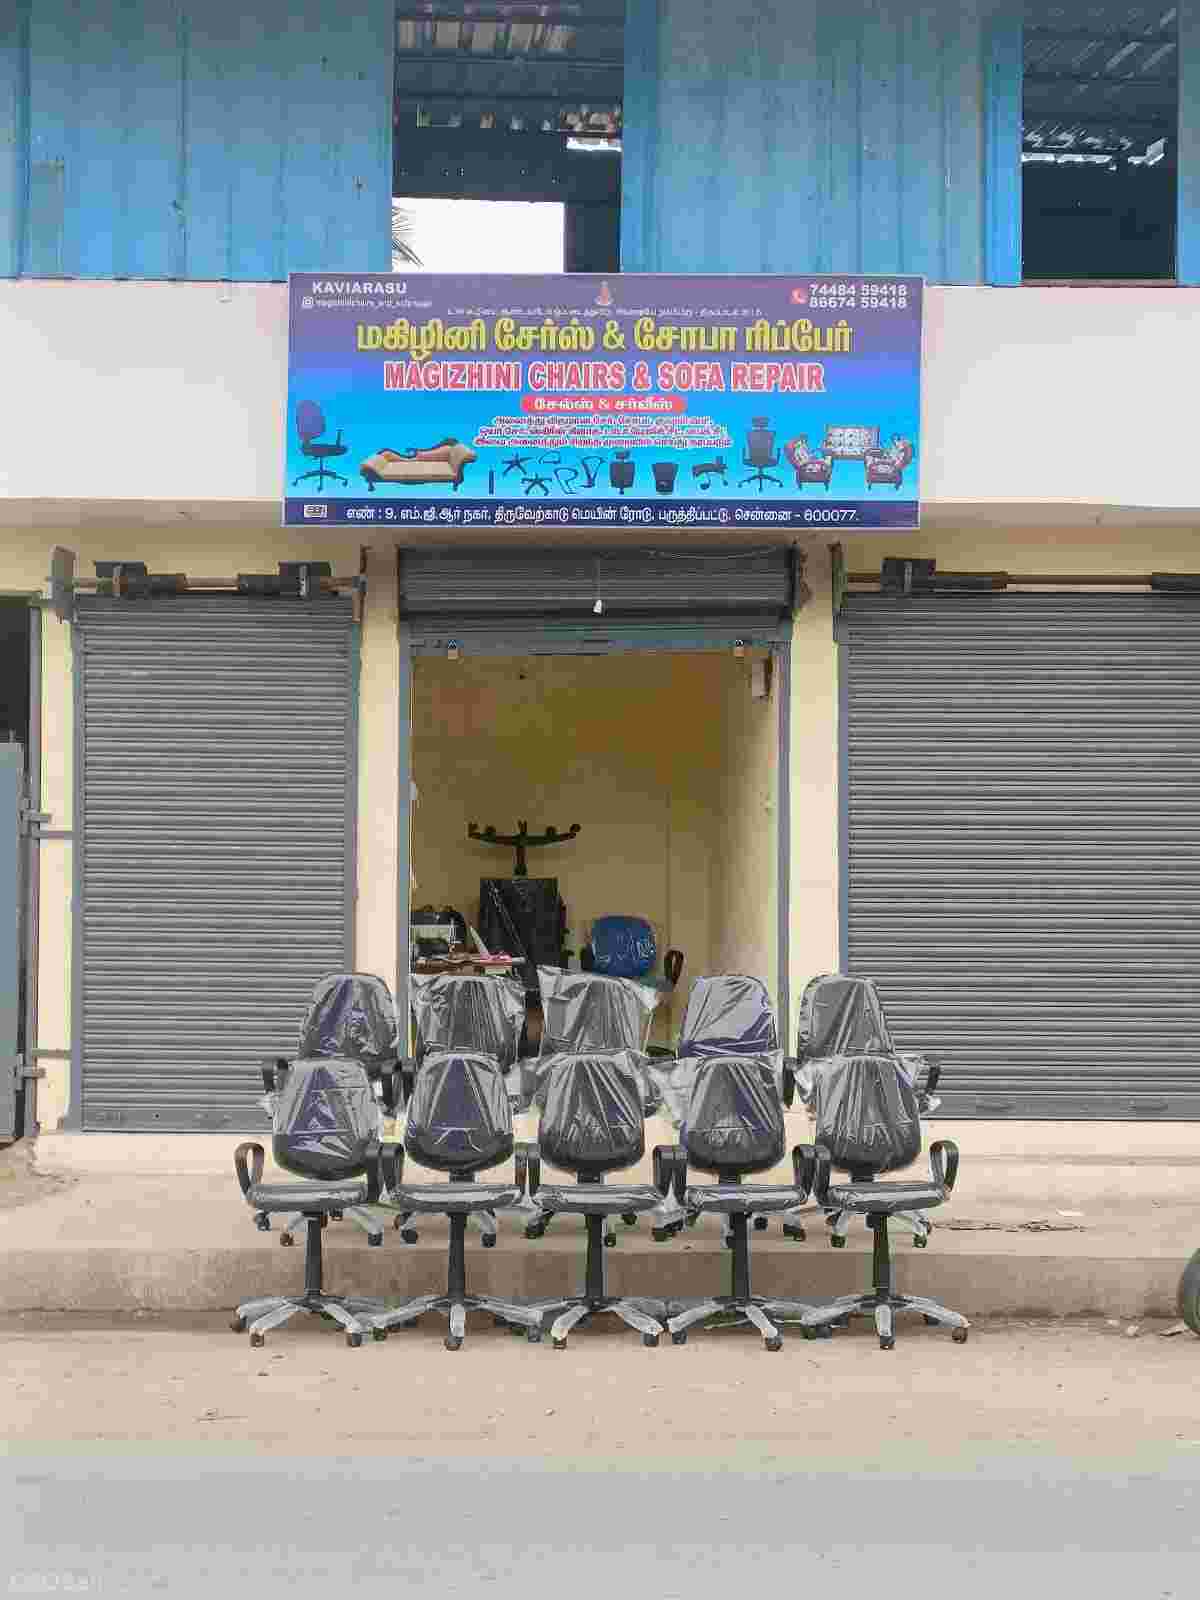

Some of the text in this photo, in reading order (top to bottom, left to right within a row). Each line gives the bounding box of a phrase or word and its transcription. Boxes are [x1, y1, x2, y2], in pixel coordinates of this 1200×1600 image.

[312, 281, 407, 294] KAVIARASU
[810, 284, 908, 297] 74484 59418
[810, 297, 908, 309] 86674 59418
[356, 318, 853, 361] மகிழினி சேர்ஸ் & சோபா ரிப்பேர்
[384, 361, 826, 392] MAGIZHINI CHAIRS & SOFA REPAIR
[598, 398, 609, 410] &
[346, 505, 375, 519] எண்
[571, 506, 617, 521] மெயின்
[735, 507, 792, 521] சென்னை
